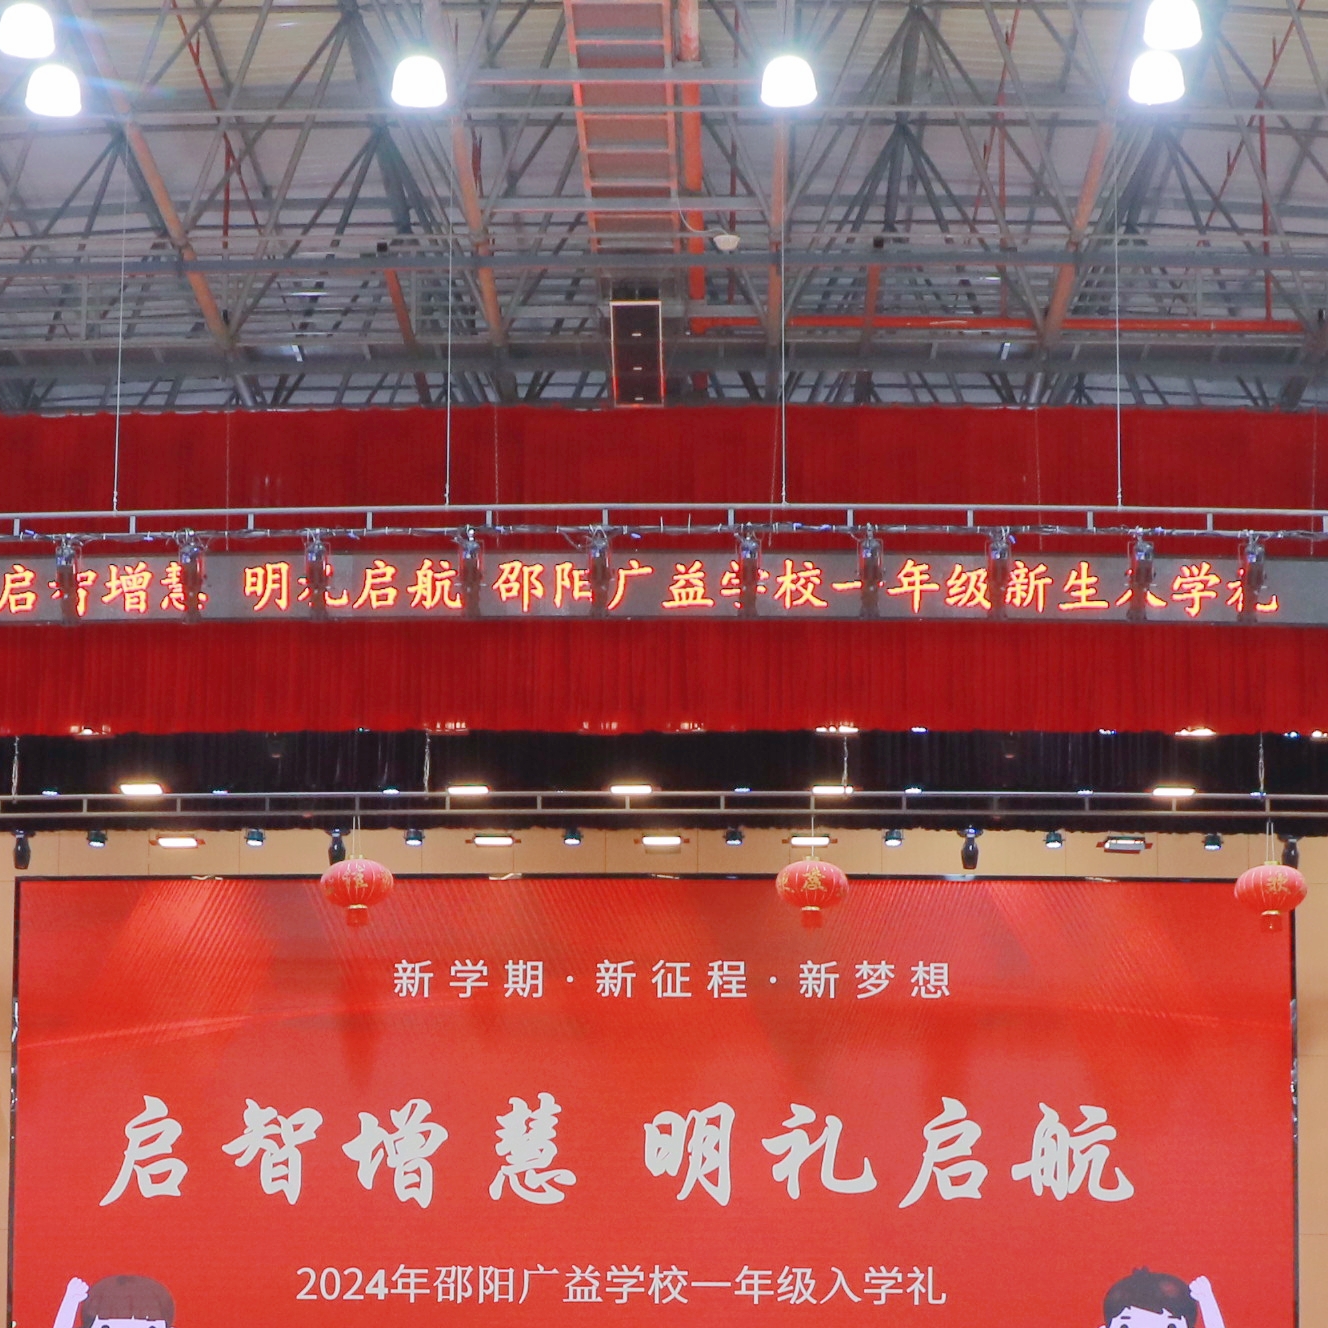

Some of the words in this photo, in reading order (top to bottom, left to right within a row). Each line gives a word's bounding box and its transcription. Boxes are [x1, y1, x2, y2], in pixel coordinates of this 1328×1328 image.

[99, 1092, 577, 1209] 启智增慧
[643, 1096, 1135, 1209] 明礼启航
[296, 1263, 947, 1306] 2024年邵阳广益学校一年级入学礼
